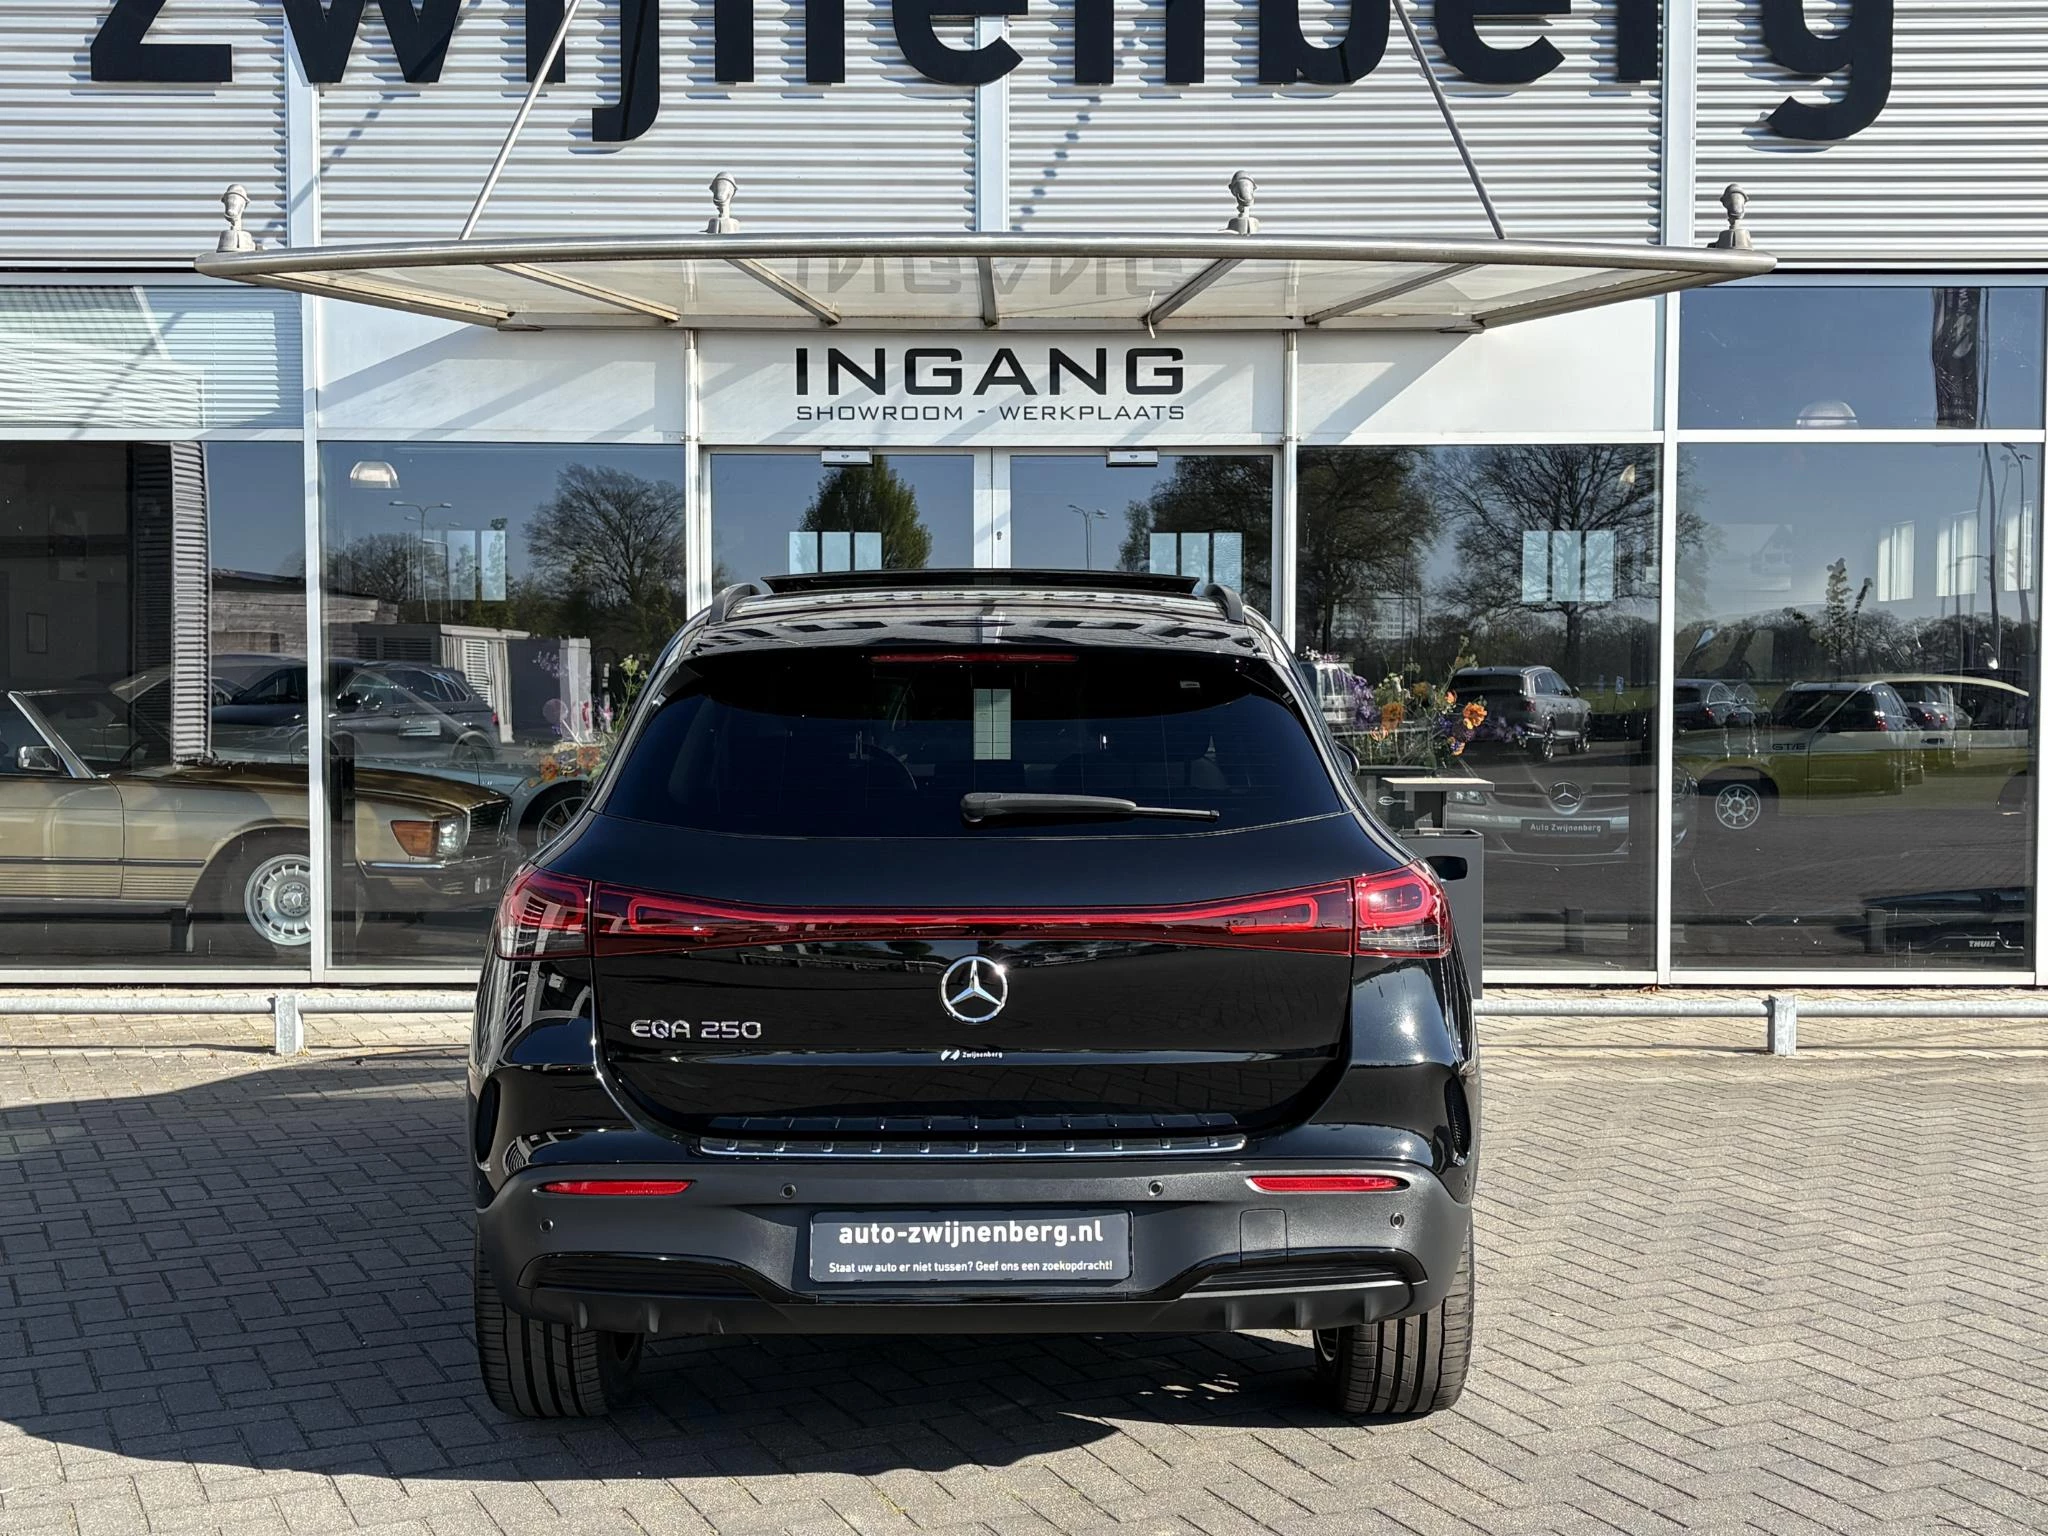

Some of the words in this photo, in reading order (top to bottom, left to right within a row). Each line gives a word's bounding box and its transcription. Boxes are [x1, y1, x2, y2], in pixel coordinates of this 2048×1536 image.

[795, 347, 1184, 396] INGANG
[796, 405, 963, 421] SHOWROOM
[998, 405, 1184, 421] WERKPLAATS
[1530, 823, 1549, 832] Auto
[1551, 823, 1602, 833] Zwijnenberg
[1969, 940, 1996, 948] THULE
[630, 1019, 691, 1039] EQA
[701, 1020, 762, 1039] 250
[962, 1050, 1003, 1059] Zwijnenberg
[838, 1219, 1104, 1248] auto-zwijnenberg.nl
[828, 1261, 856, 1273] Staat
[857, 1264, 872, 1273] uw
[874, 1262, 898, 1273] auto
[898, 1264, 911, 1273] er
[912, 1261, 933, 1272] niet
[933, 1261, 973, 1272] tussen?
[975, 1260, 999, 1272] Geef
[1000, 1263, 1020, 1272] ons
[1021, 1262, 1040, 1272] een
[1042, 1260, 1114, 1273] zoekopdracht!
